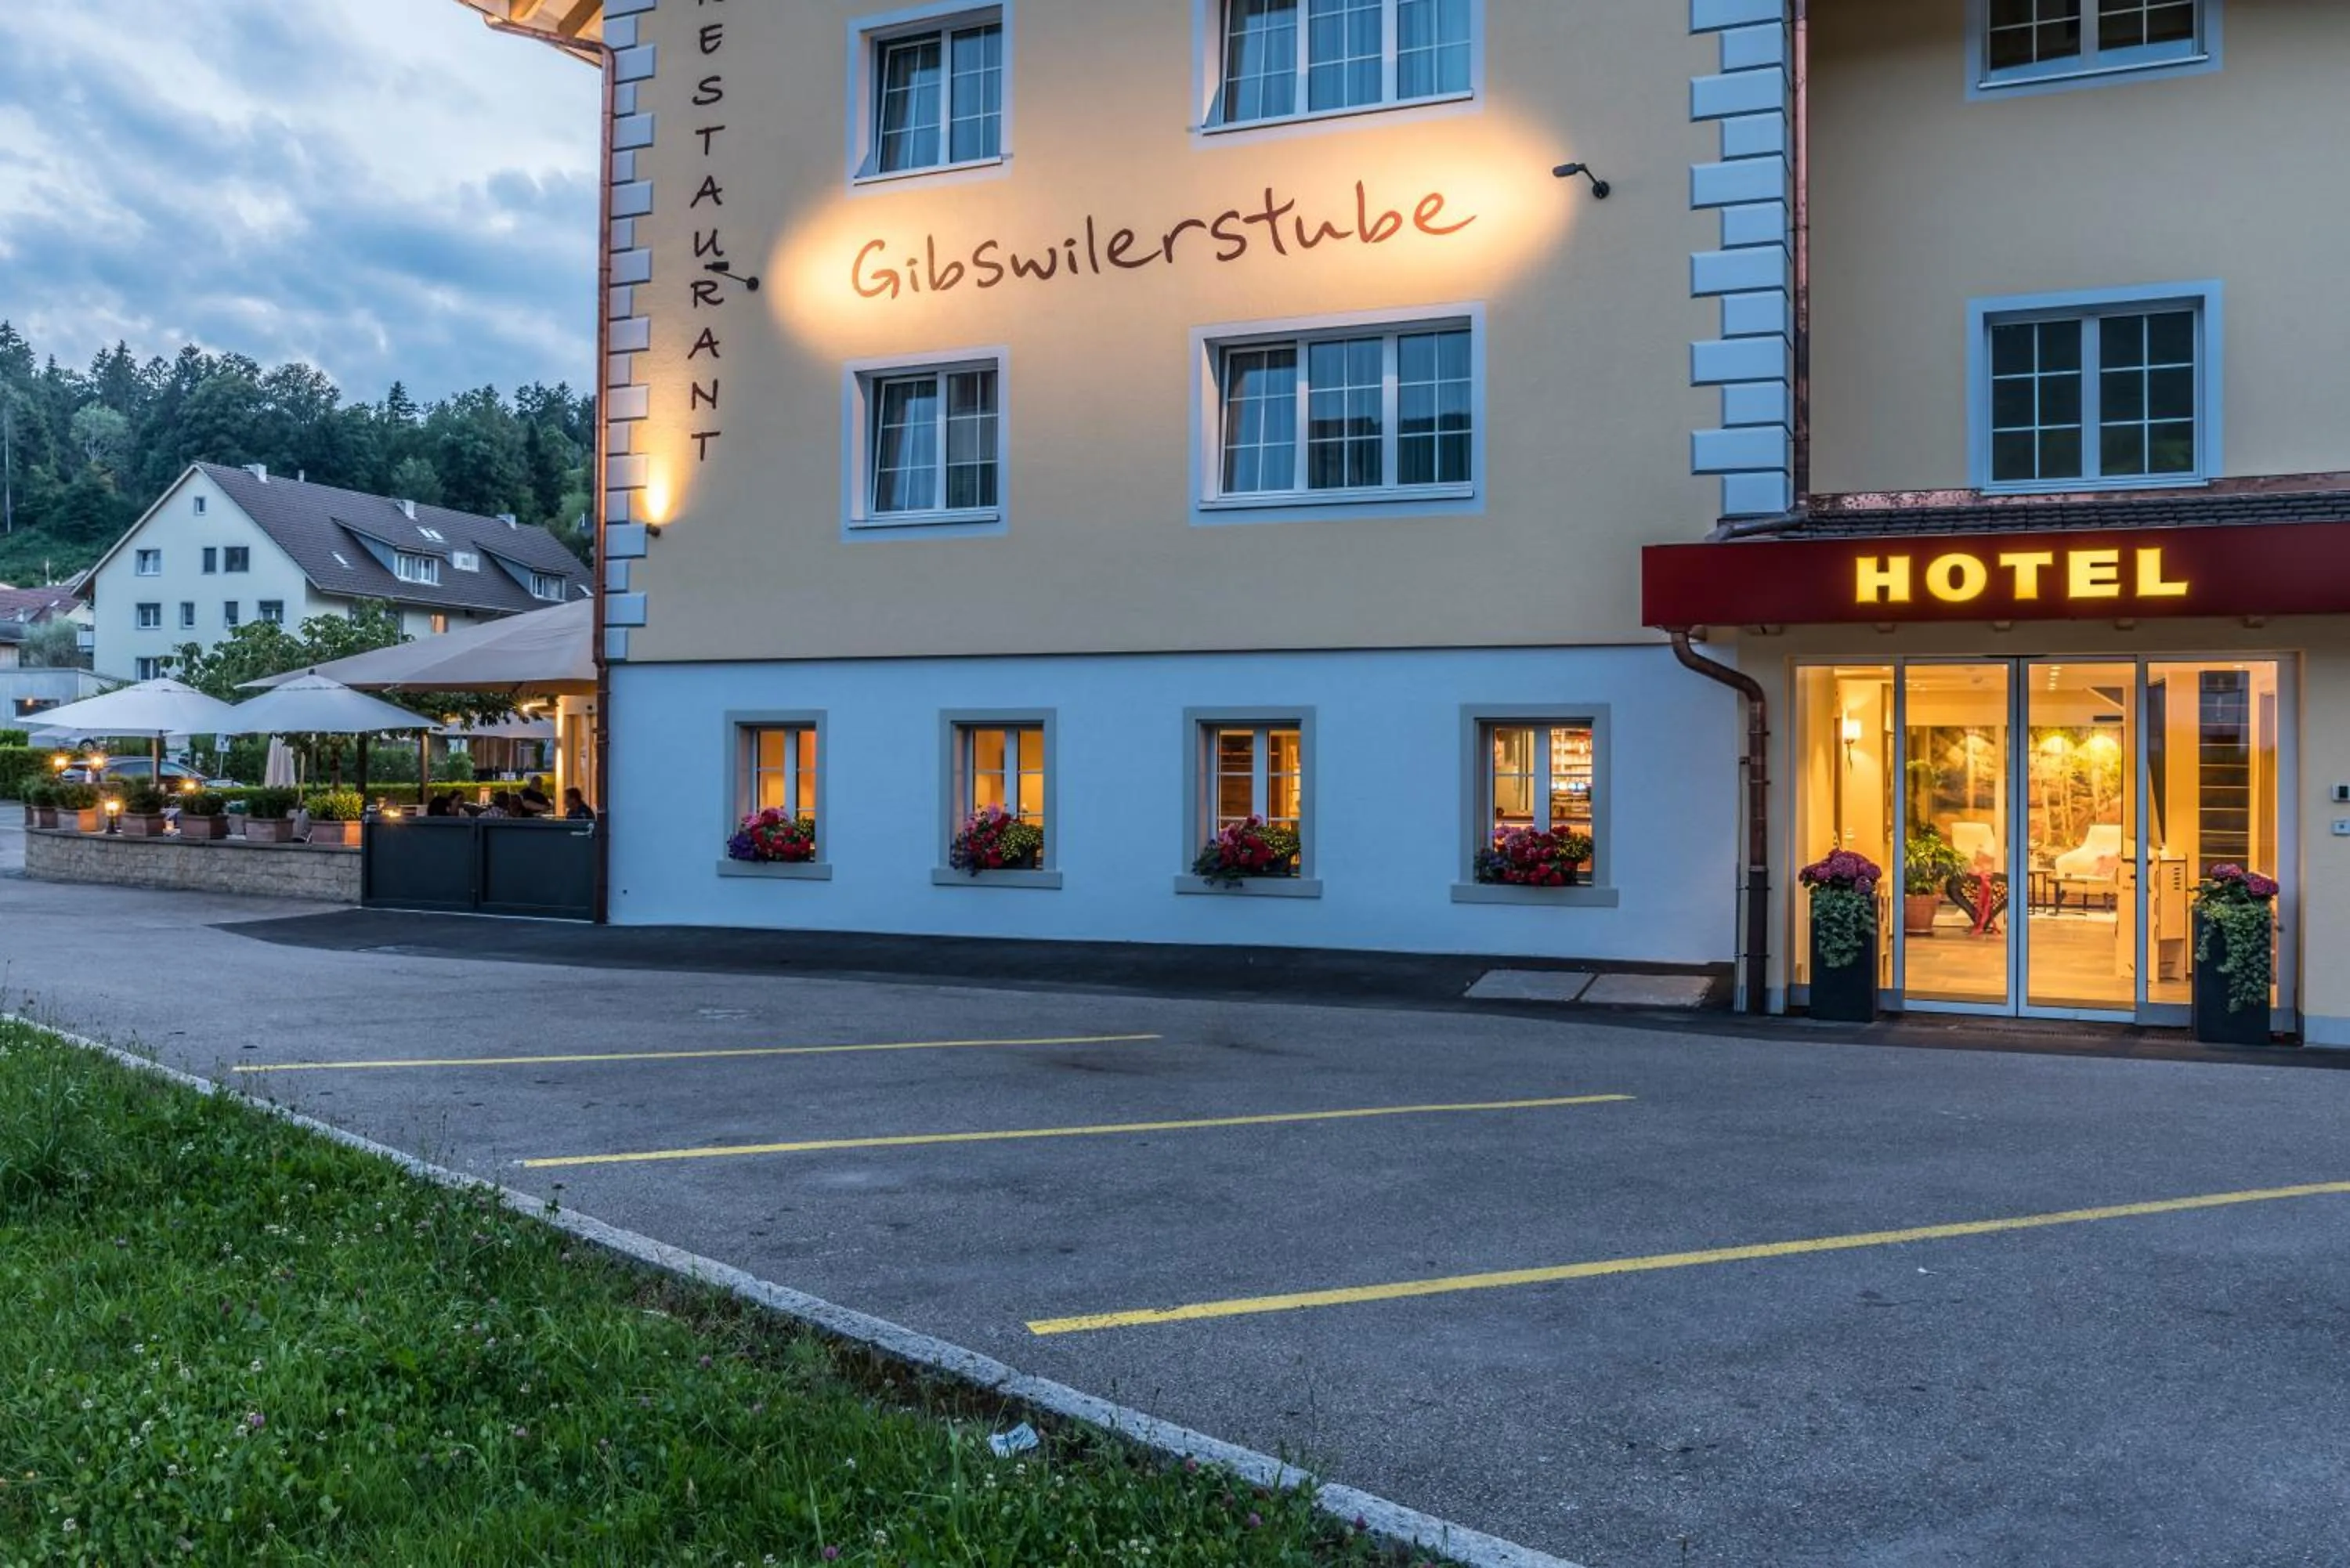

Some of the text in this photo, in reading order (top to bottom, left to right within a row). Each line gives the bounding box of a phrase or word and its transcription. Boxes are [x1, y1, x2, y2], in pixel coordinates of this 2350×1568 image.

[688, 0, 725, 461] ESTAURANT
[851, 180, 1477, 300] Gibswilerstube
[1855, 548, 2189, 603] HOTEL
